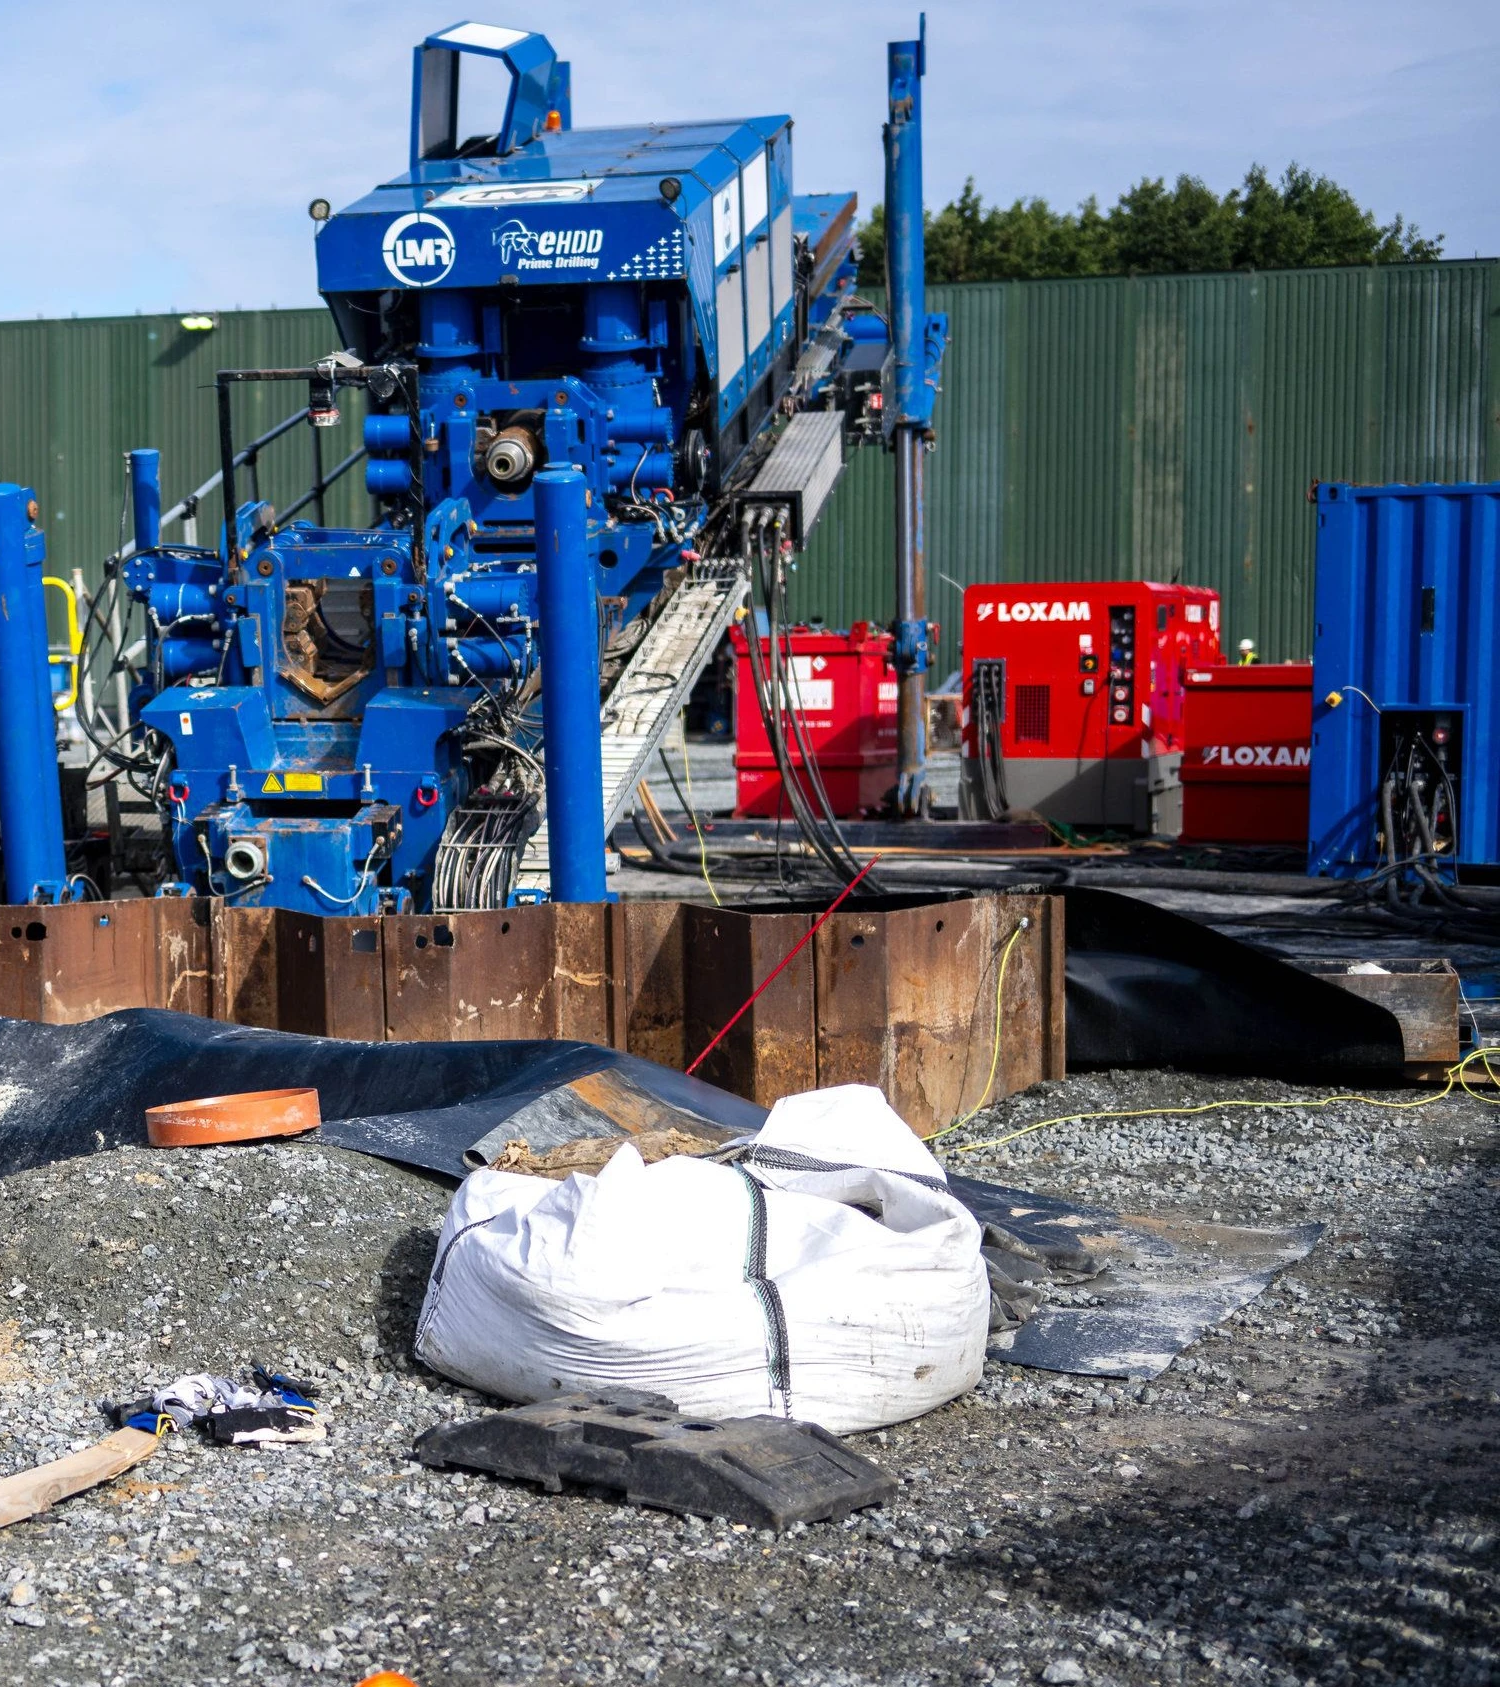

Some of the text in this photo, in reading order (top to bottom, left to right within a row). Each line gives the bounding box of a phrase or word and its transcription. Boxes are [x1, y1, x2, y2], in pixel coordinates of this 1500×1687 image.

[396, 238, 452, 267] LMR
[538, 229, 603, 256] eHDD
[517, 255, 600, 270] Prime Drilling
[998, 601, 1091, 622] LOXAM
